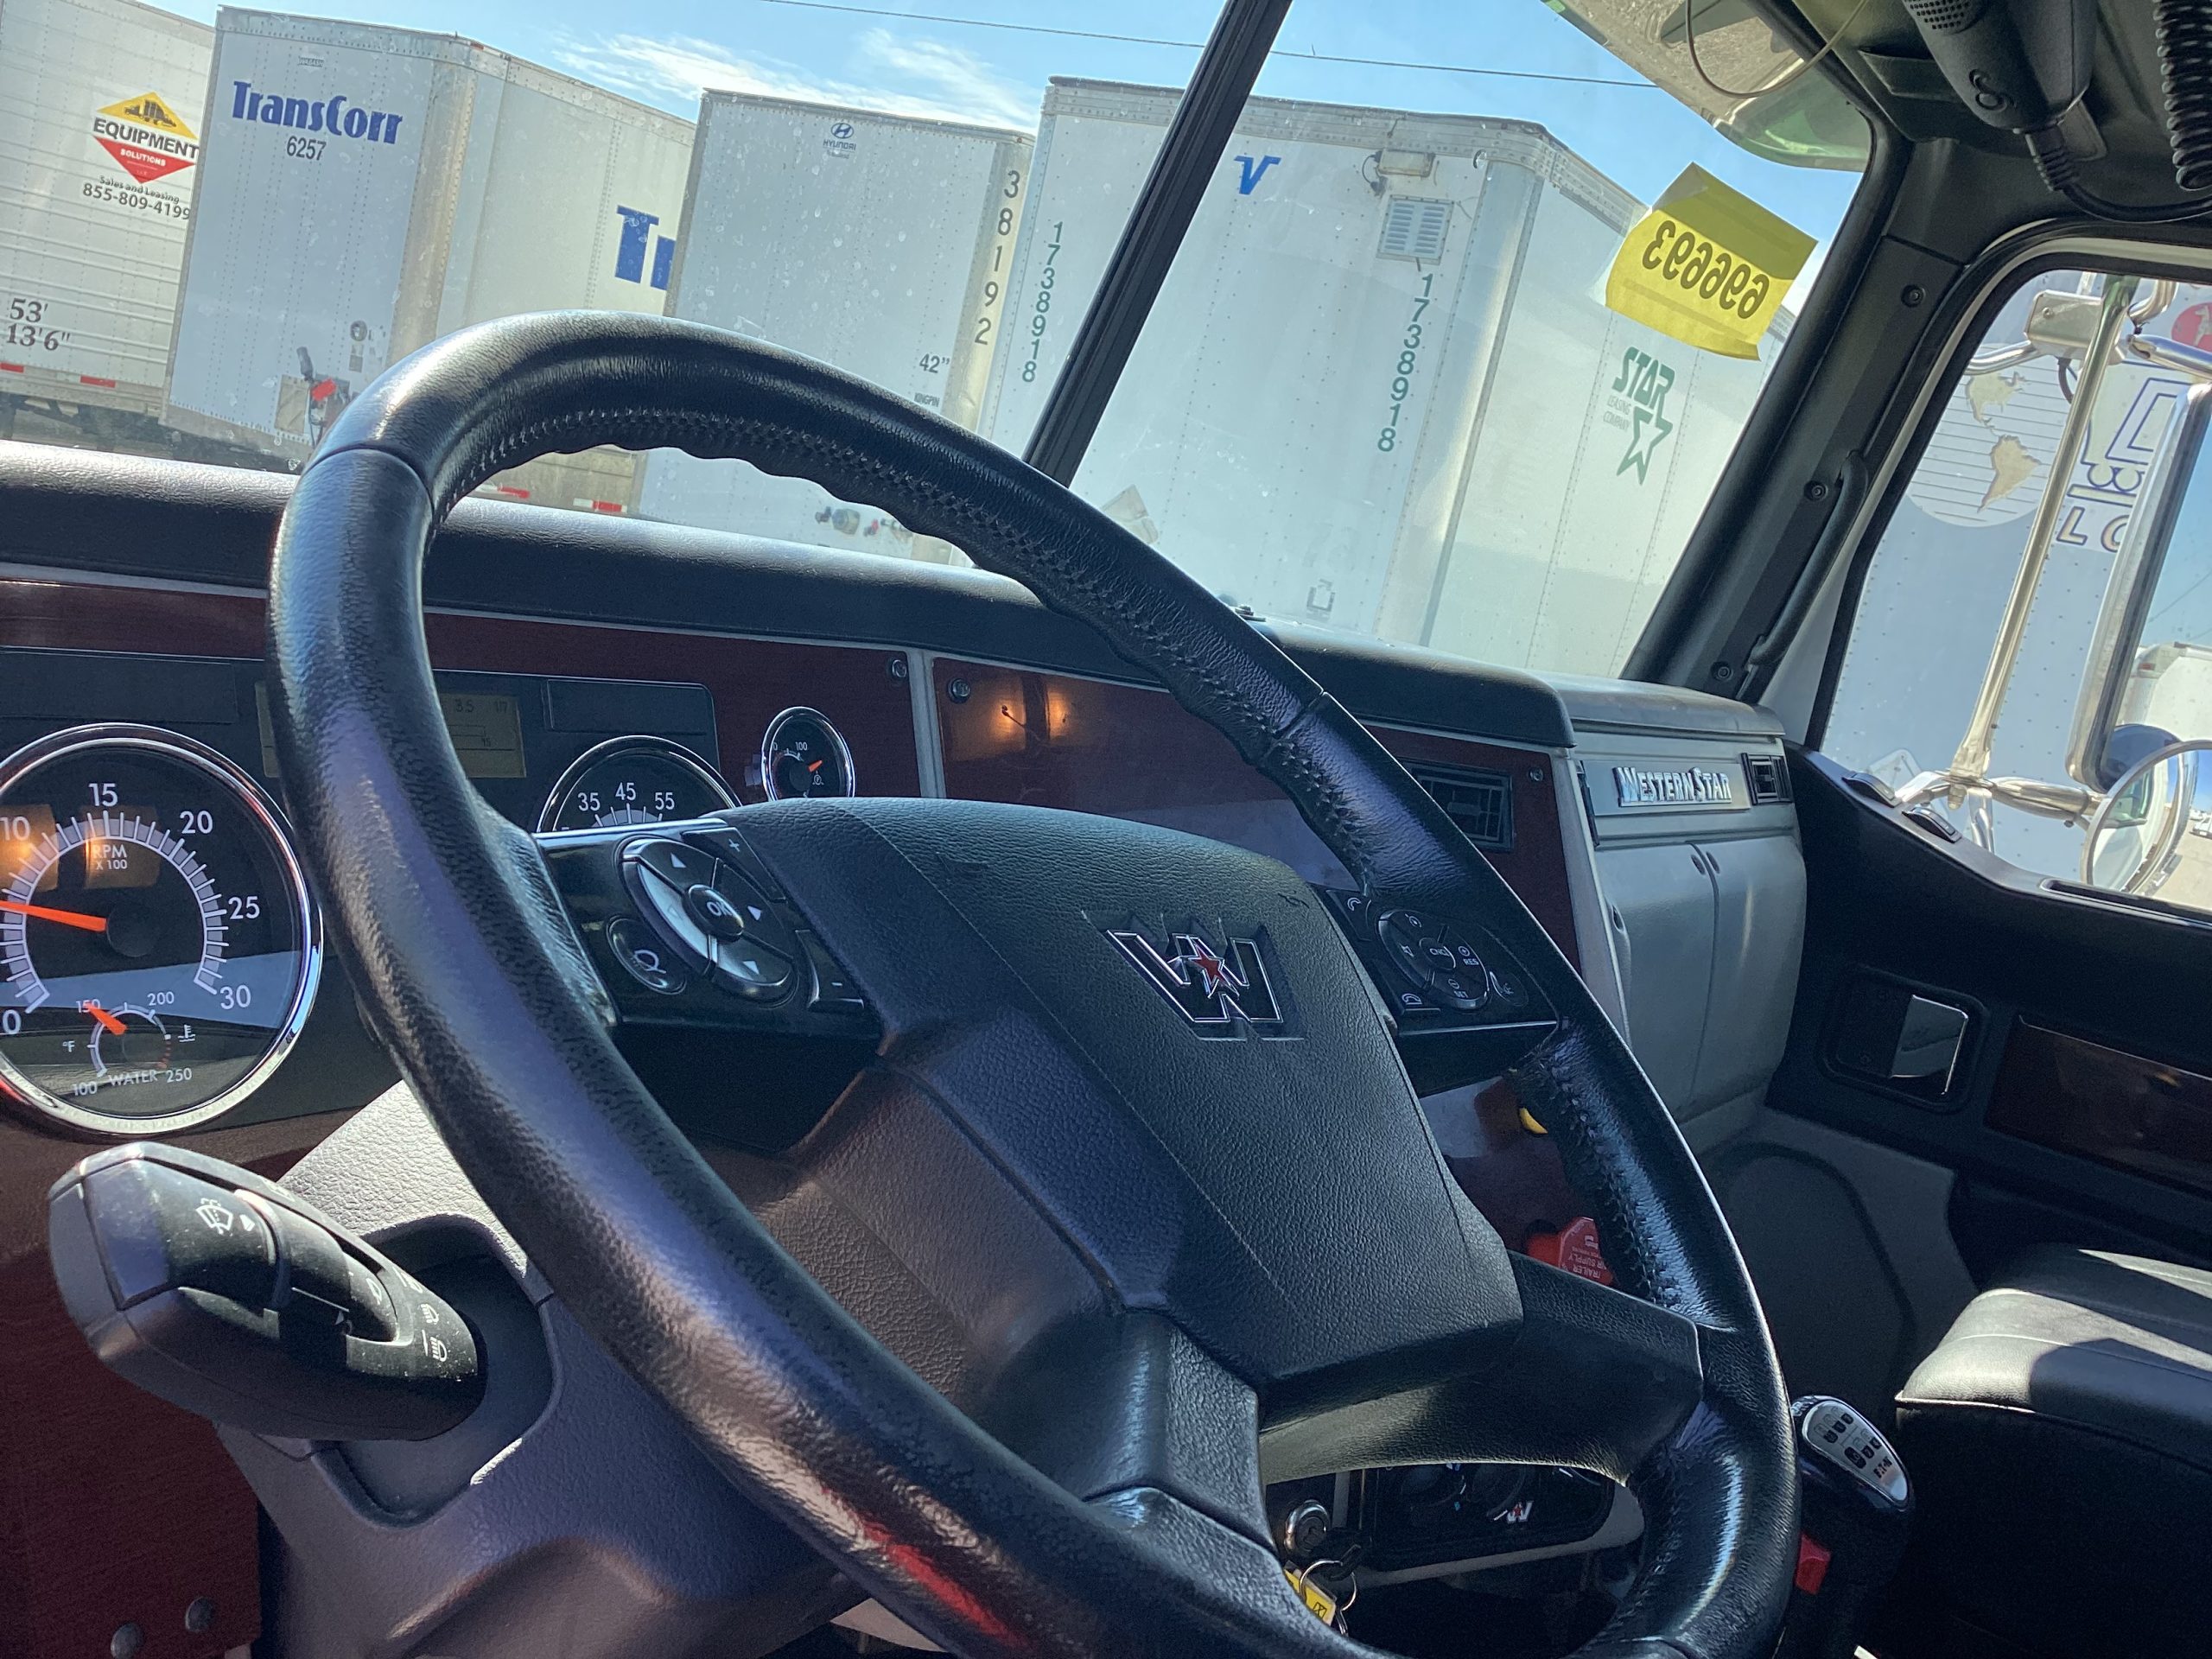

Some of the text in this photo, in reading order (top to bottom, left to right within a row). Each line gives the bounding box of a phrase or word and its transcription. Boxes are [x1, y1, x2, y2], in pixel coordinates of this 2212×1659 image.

[232, 80, 403, 145] TransCorr
[93, 117, 200, 159] EQUIPMENT
[287, 135, 327, 161] 6257
[823, 138, 856, 151] HYUNDAI
[120, 148, 167, 167] SOLUTIONS
[83, 182, 191, 220] 855-809-4199
[99, 176, 180, 205] Sales and Leasing
[975, 169, 1020, 346] 38192
[10, 297, 48, 323] 53'
[1022, 221, 1063, 382] 1738918
[1377, 273, 1433, 452] 1738918
[1611, 346, 1675, 410] STAR
[796, 742, 808, 751] 100
[88, 783, 118, 807] 15
[577, 792, 601, 811] 35
[615, 782, 637, 801] 45
[654, 792, 675, 810] 55
[0, 816, 31, 842] 10
[180, 810, 213, 834] 20
[92, 844, 127, 859] RPM
[107, 860, 128, 870] 100
[228, 896, 260, 920] 25
[147, 991, 175, 1007] 200
[219, 984, 251, 1009] 30
[3, 1009, 22, 1035] 0
[108, 1070, 158, 1086] WATER
[166, 1067, 193, 1084] 250
[73, 1081, 98, 1096] 100
[1573, 1264, 1601, 1279] TRAILER
